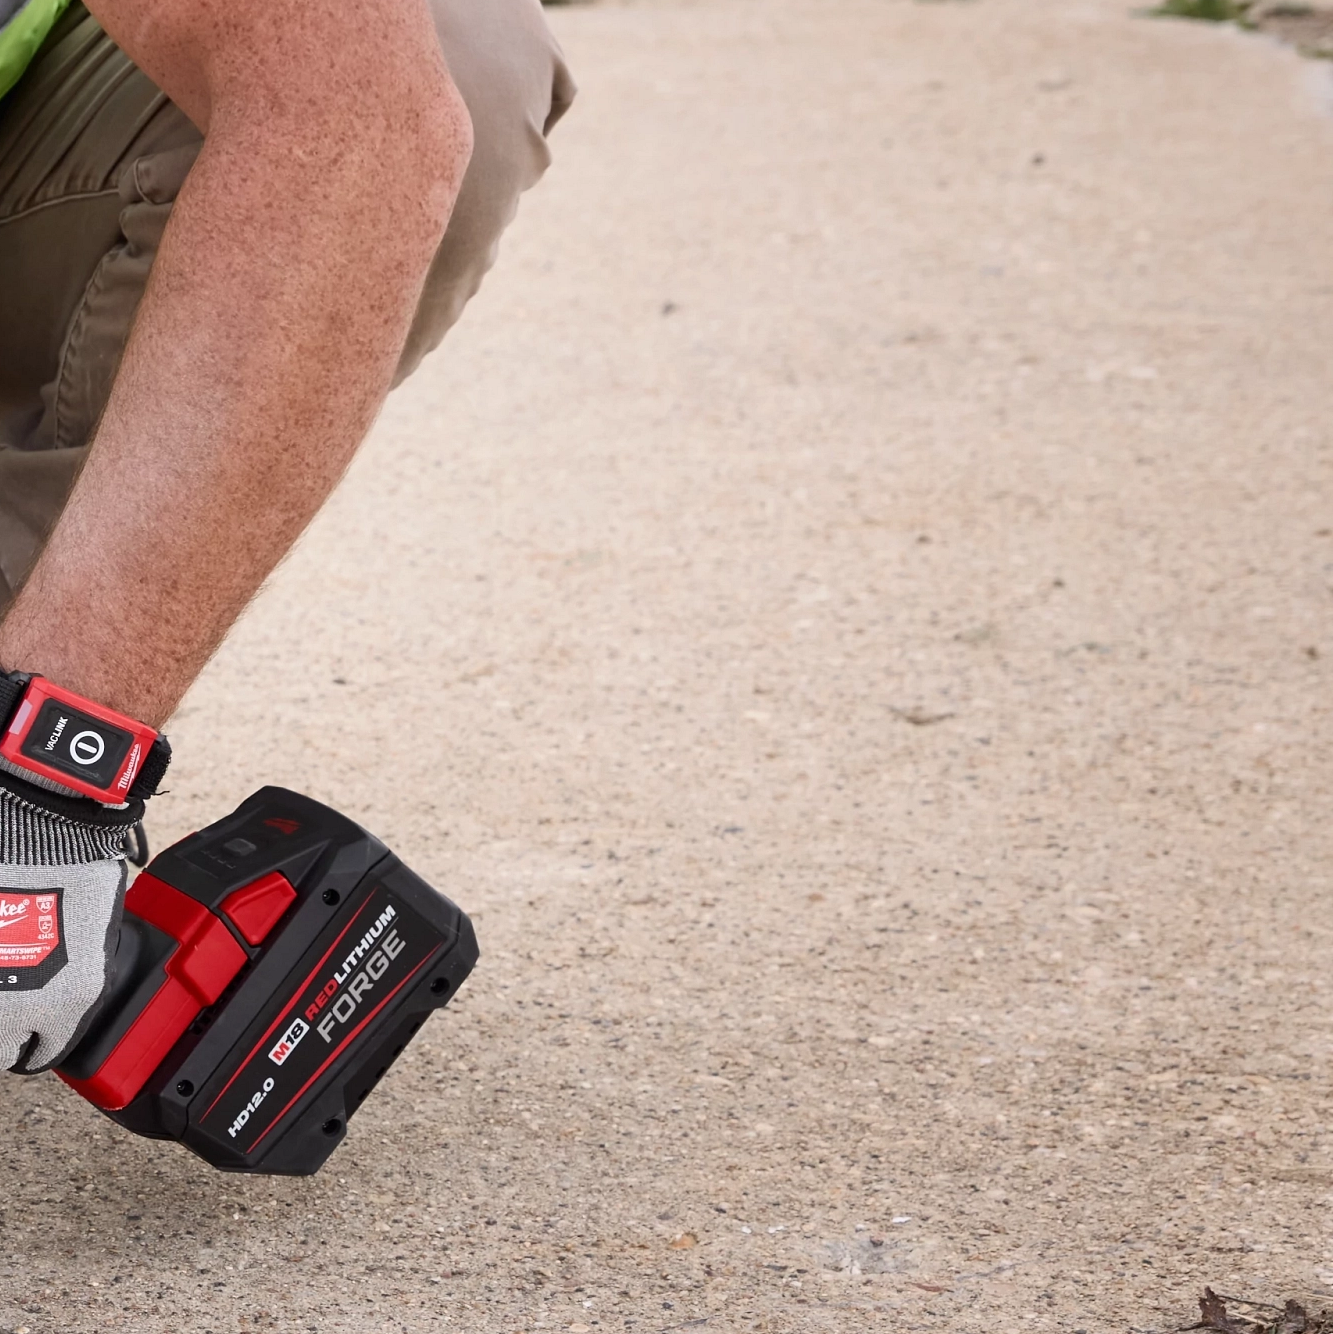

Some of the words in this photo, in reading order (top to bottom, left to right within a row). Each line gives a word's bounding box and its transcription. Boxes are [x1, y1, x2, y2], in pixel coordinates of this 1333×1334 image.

[45, 716, 68, 751] VACLINK
[117, 743, 139, 790] Milwaukee
[7, 975, 18, 984] 3
[316, 929, 407, 1044] FORGE
[227, 1077, 275, 1138] HD12.0
[271, 1022, 305, 1062] M18
[304, 904, 397, 1022] REDLITHIUM
